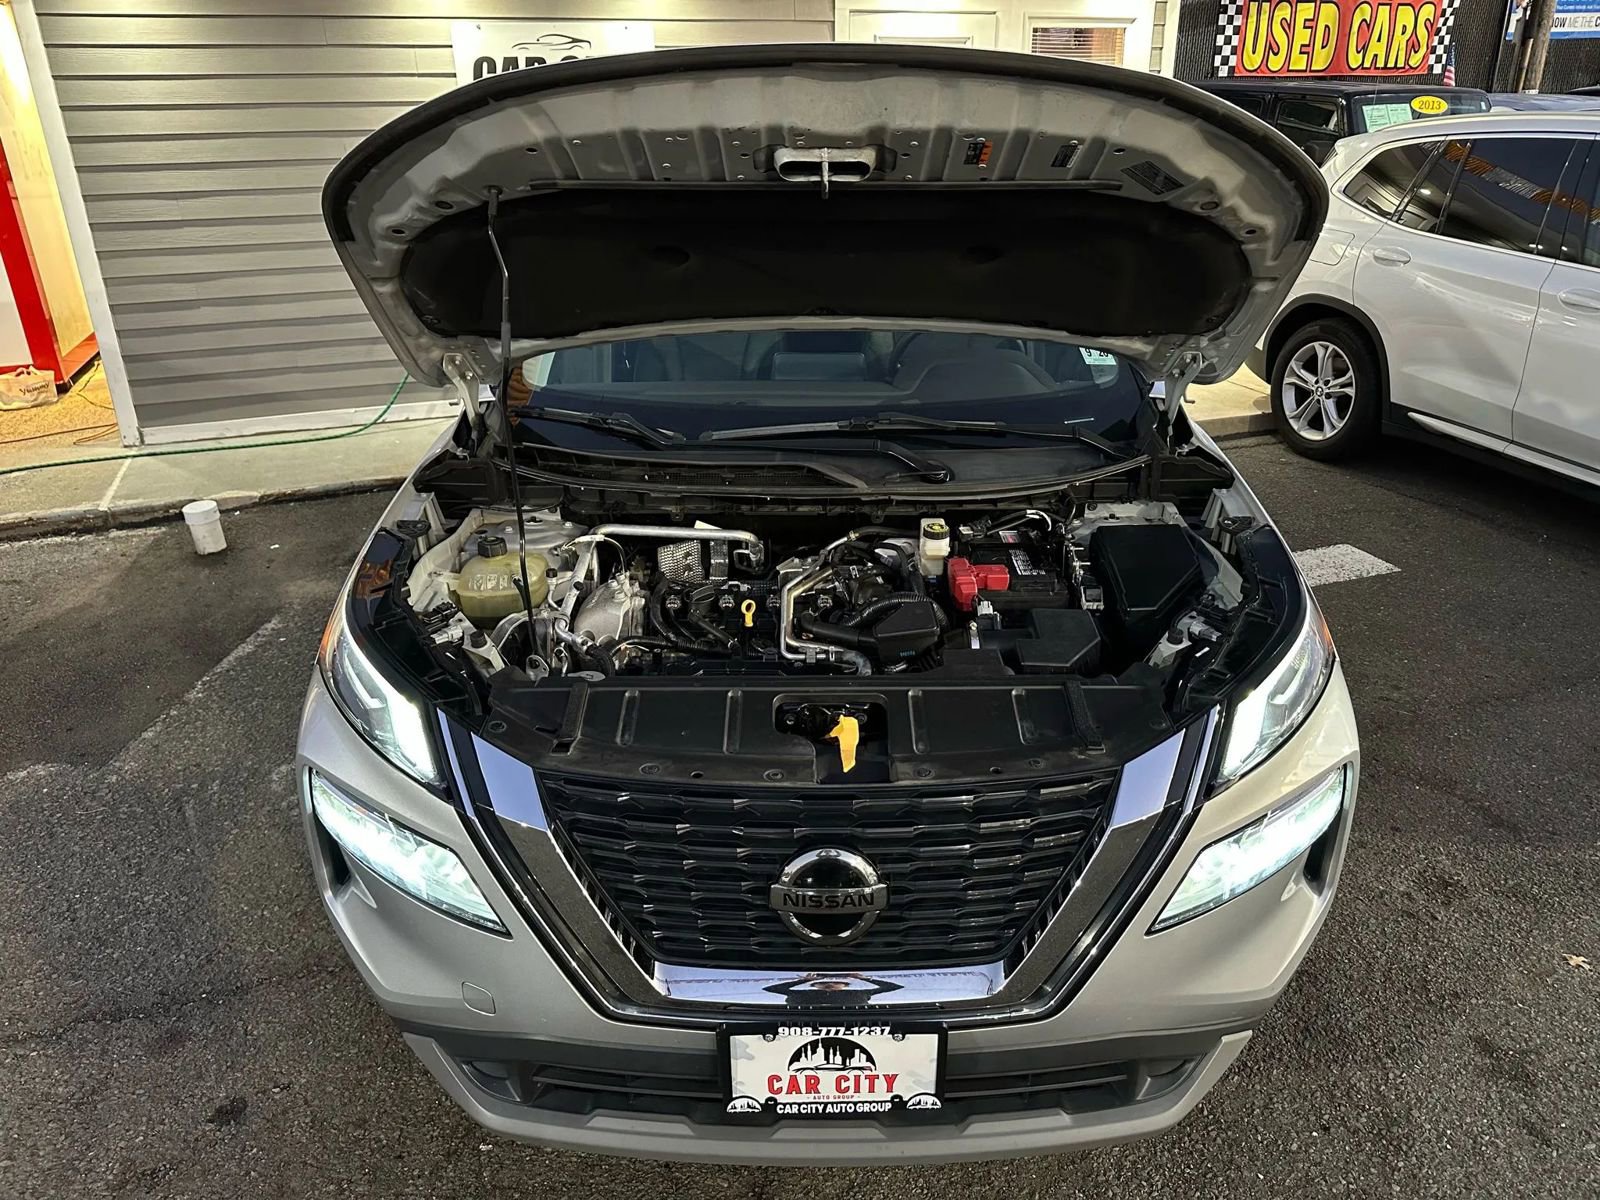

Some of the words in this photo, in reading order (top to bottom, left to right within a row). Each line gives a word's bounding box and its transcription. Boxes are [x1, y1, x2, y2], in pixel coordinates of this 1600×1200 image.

[1241, 0, 1340, 72] USED
[1346, 1, 1436, 70] CARS
[1418, 100, 1442, 111] 2013
[783, 893, 875, 908] NISSAN
[778, 1026, 891, 1037] 908-777-1237
[767, 1074, 822, 1095] CAR
[835, 1073, 899, 1094] CITY
[776, 1104, 799, 1114] CAR
[800, 1103, 825, 1113] CITY
[825, 1102, 855, 1113] AUTO
[856, 1102, 892, 1113] GROUP
